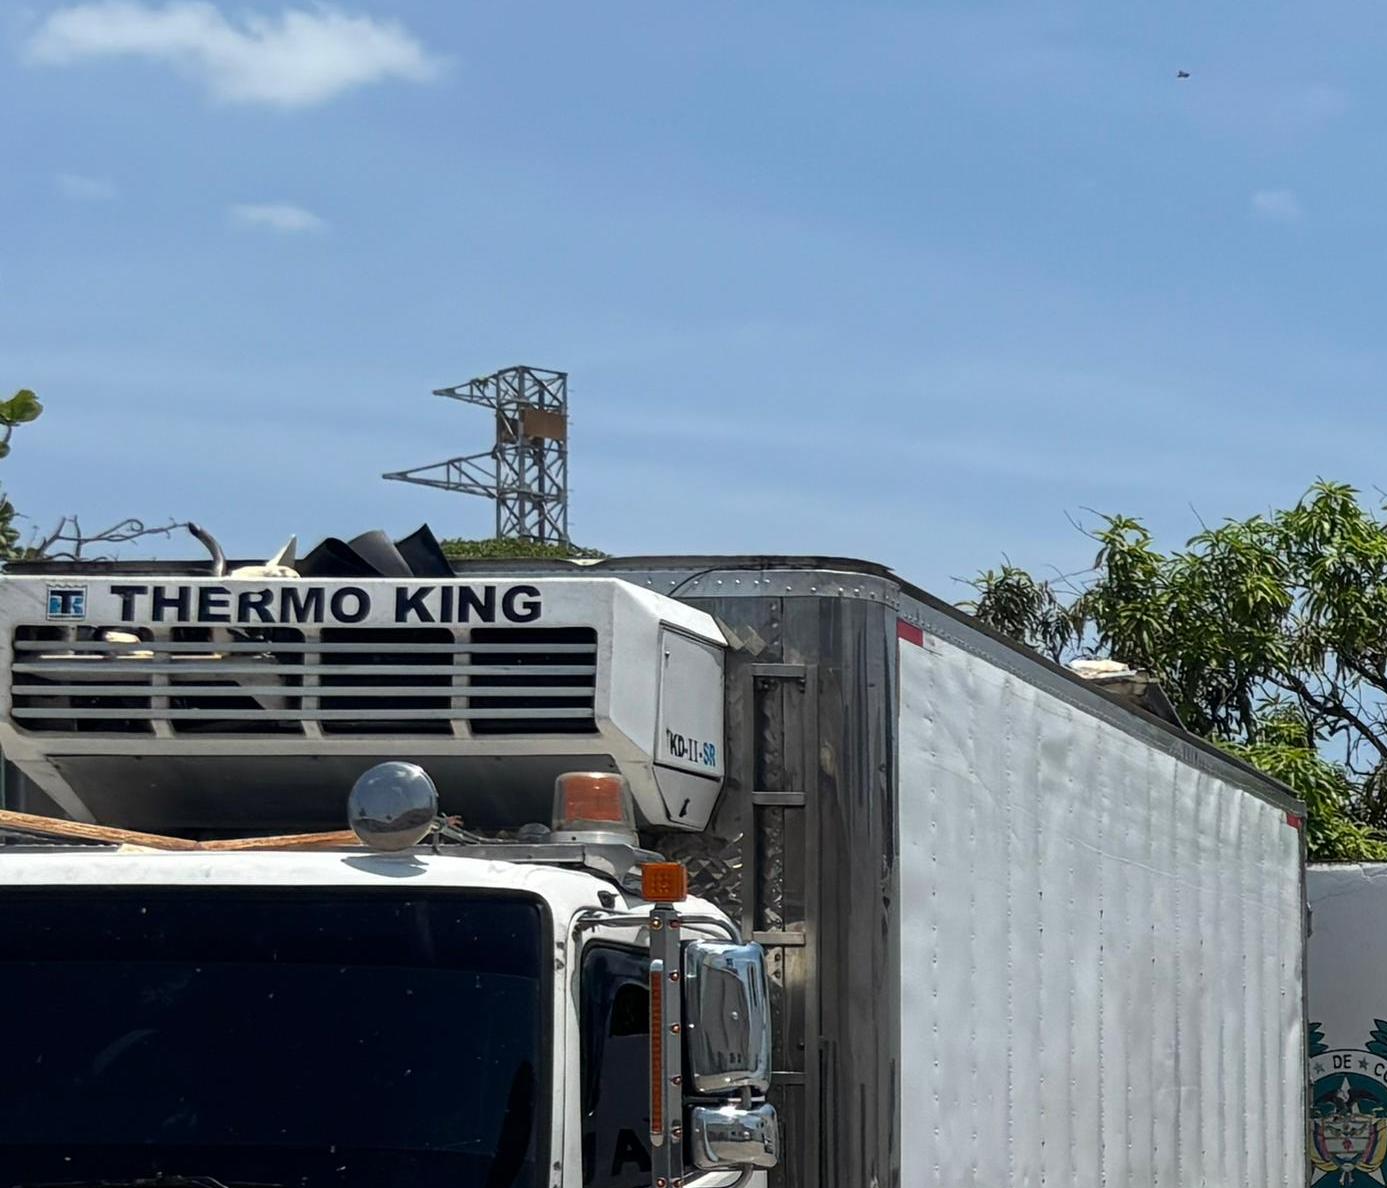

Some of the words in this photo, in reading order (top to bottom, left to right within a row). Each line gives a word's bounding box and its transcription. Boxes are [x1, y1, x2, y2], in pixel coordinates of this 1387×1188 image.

[110, 585, 371, 623] THERMO
[395, 584, 542, 623] KING
[1333, 1054, 1352, 1069] DE
